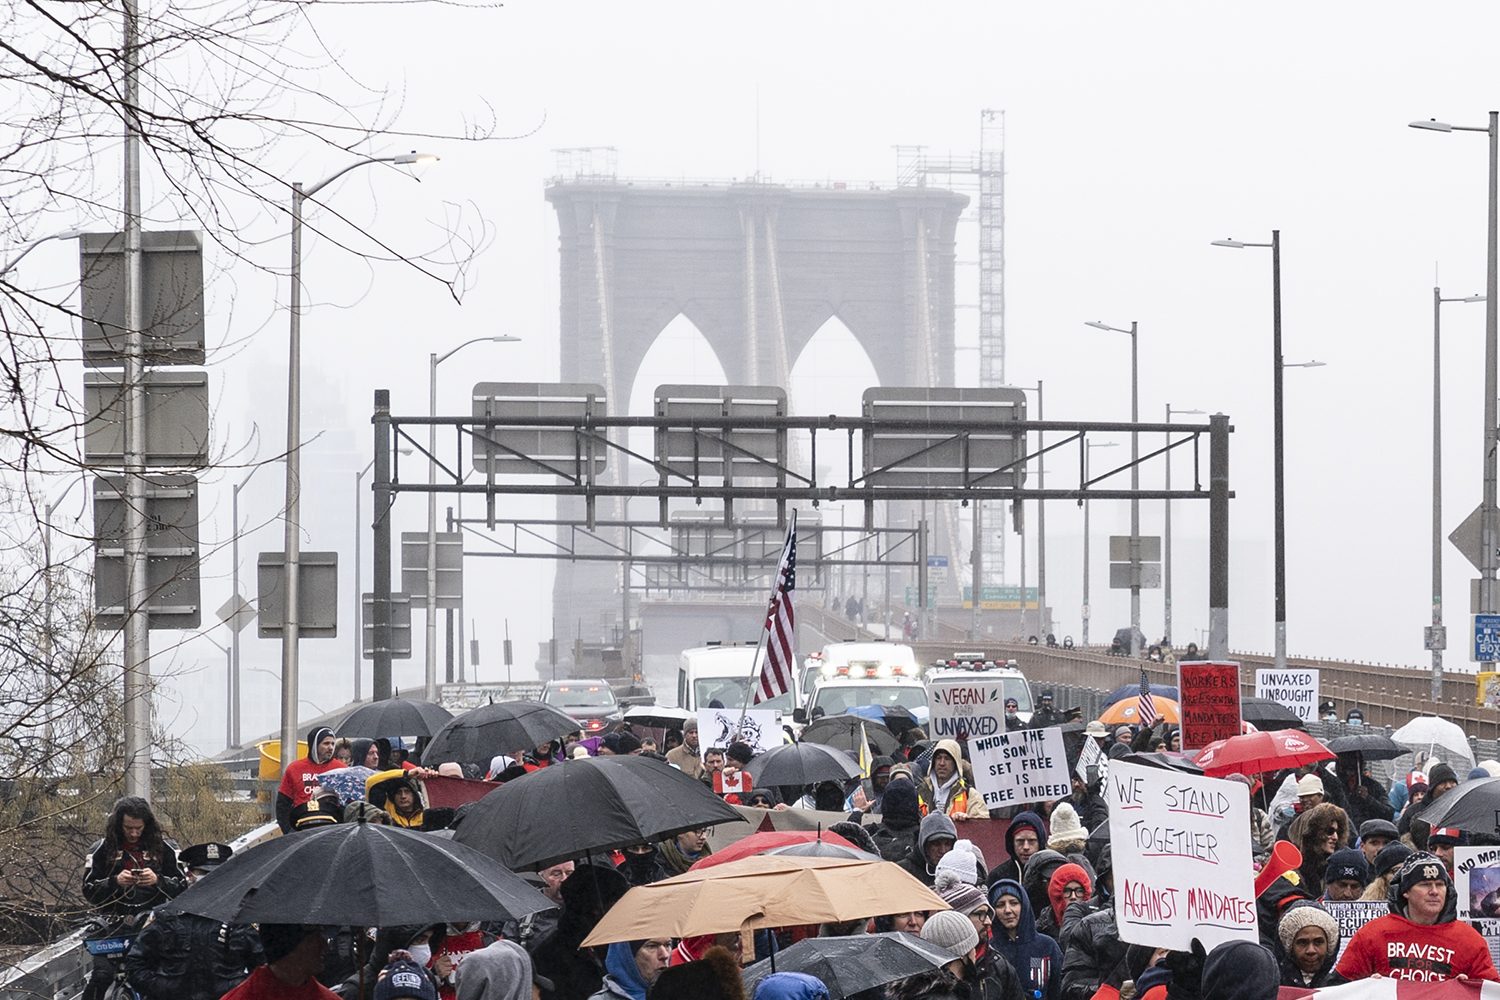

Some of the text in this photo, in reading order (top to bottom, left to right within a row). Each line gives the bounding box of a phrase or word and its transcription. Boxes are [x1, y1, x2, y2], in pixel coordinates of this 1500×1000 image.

[1480, 644, 1500, 653] BOX
[1182, 674, 1237, 688] WORKERS
[1262, 674, 1312, 686] UNVAXED
[942, 688, 985, 705] VEGAN
[1261, 688, 1314, 702] UNBOUGHT
[1184, 710, 1238, 724] MANDATES
[934, 716, 998, 736] UNVAXXED
[976, 729, 1045, 752] WHOM THE
[1184, 729, 1209, 744] ARE
[1003, 745, 1028, 759] SON
[989, 757, 1053, 776] SET FREE
[1015, 773, 1030, 785] IS
[983, 783, 1069, 805] FREE INDEED
[1115, 775, 1230, 815] WE STAND
[1129, 820, 1220, 862] TOGETHER
[1457, 858, 1476, 875] NO
[1124, 878, 1256, 924] AGAINST MANDATES
[108, 941, 123, 949] bike
[1387, 942, 1455, 964] BRAVEST
[1407, 959, 1432, 970] FOR
